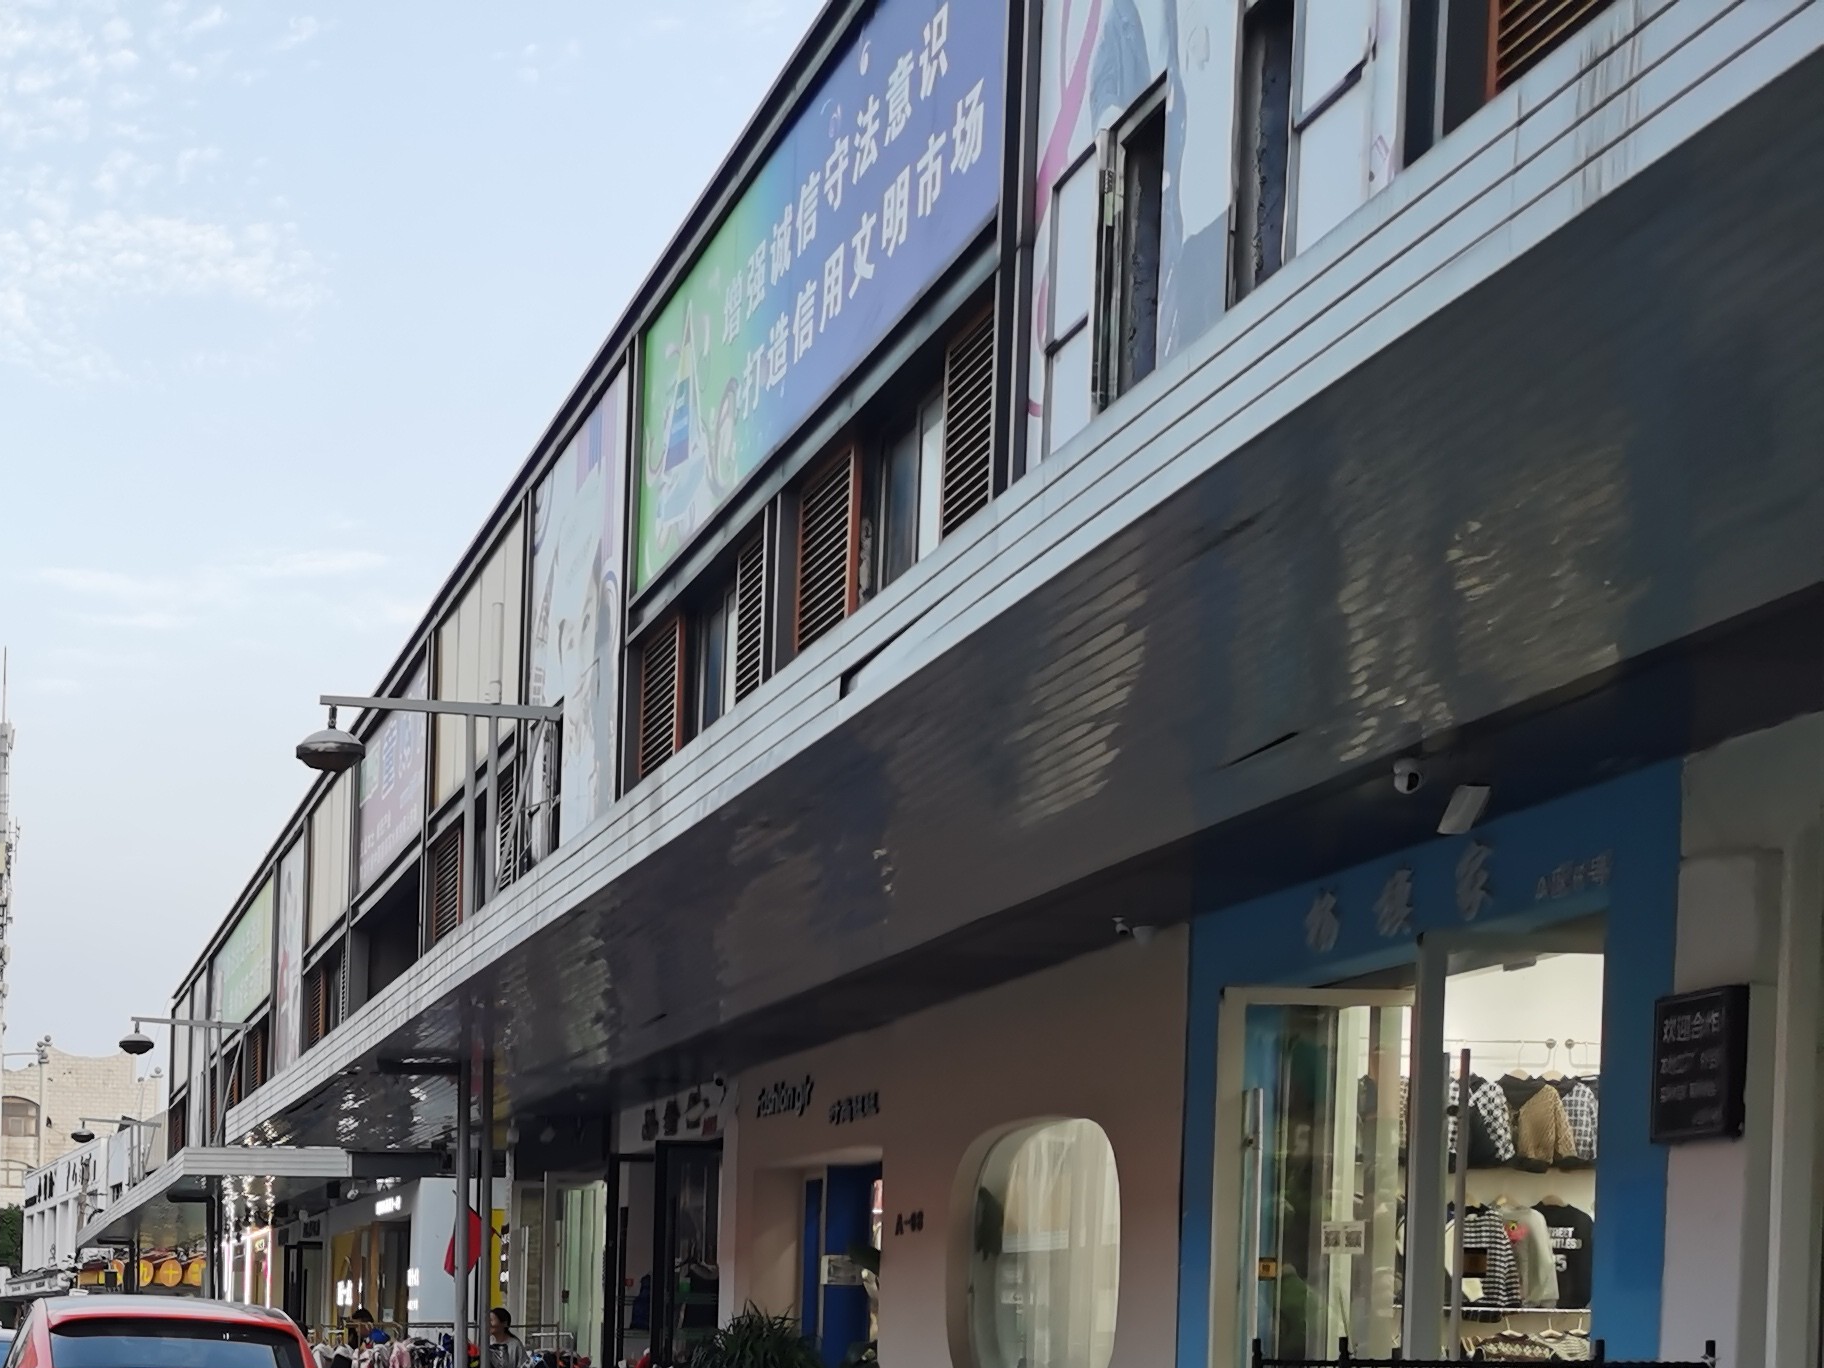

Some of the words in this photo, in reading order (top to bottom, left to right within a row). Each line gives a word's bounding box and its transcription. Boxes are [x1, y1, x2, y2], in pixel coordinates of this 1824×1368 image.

[722, 2, 950, 346] 增强诚信守法意识
[739, 78, 986, 421] 打造信用文明市场
